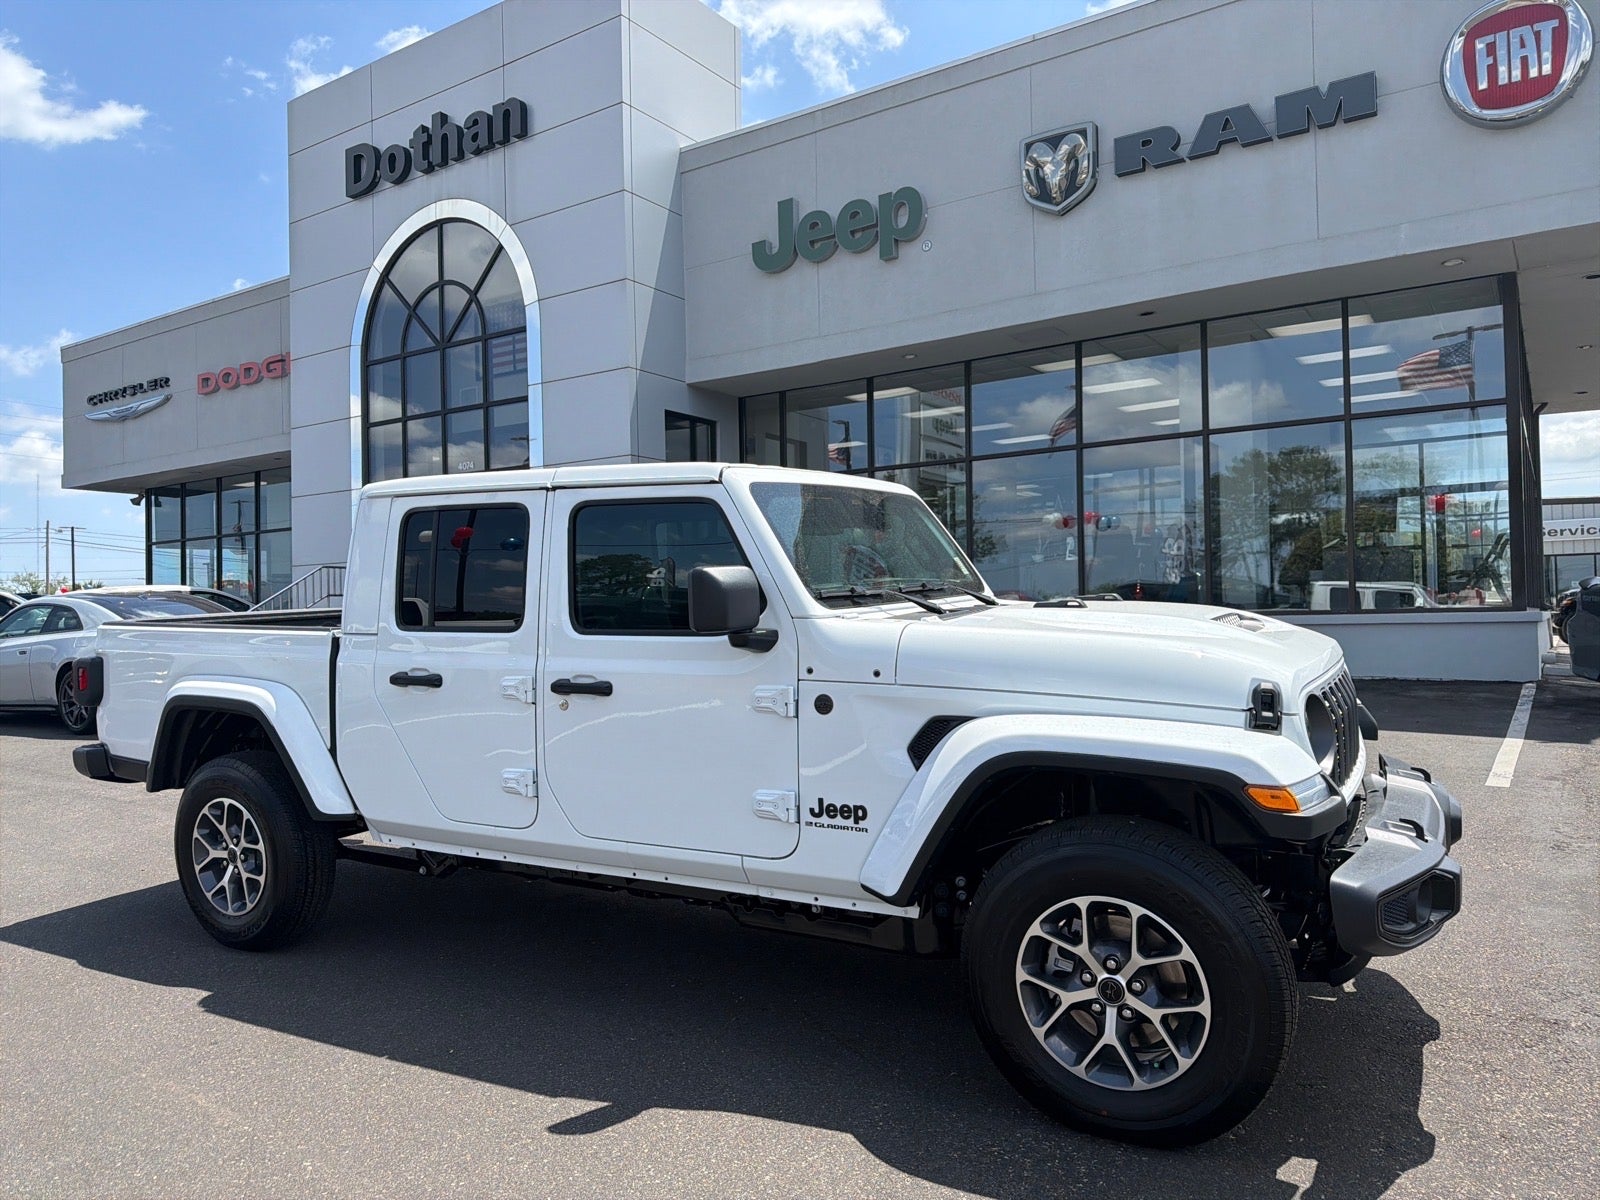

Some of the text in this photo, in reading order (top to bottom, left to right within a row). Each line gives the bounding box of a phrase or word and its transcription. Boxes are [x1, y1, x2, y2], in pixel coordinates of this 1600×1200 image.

[1475, 19, 1559, 91] FIAT
[1113, 70, 1378, 177] RAM
[345, 97, 528, 199] Dothan
[752, 186, 928, 274] Jeep
[87, 376, 171, 407] CHRYSLER
[197, 352, 290, 395] DODG
[458, 461, 474, 470] 4074
[1542, 524, 1600, 537] ervic
[809, 797, 868, 824] Jeep
[814, 822, 869, 833] GLADIATOR
